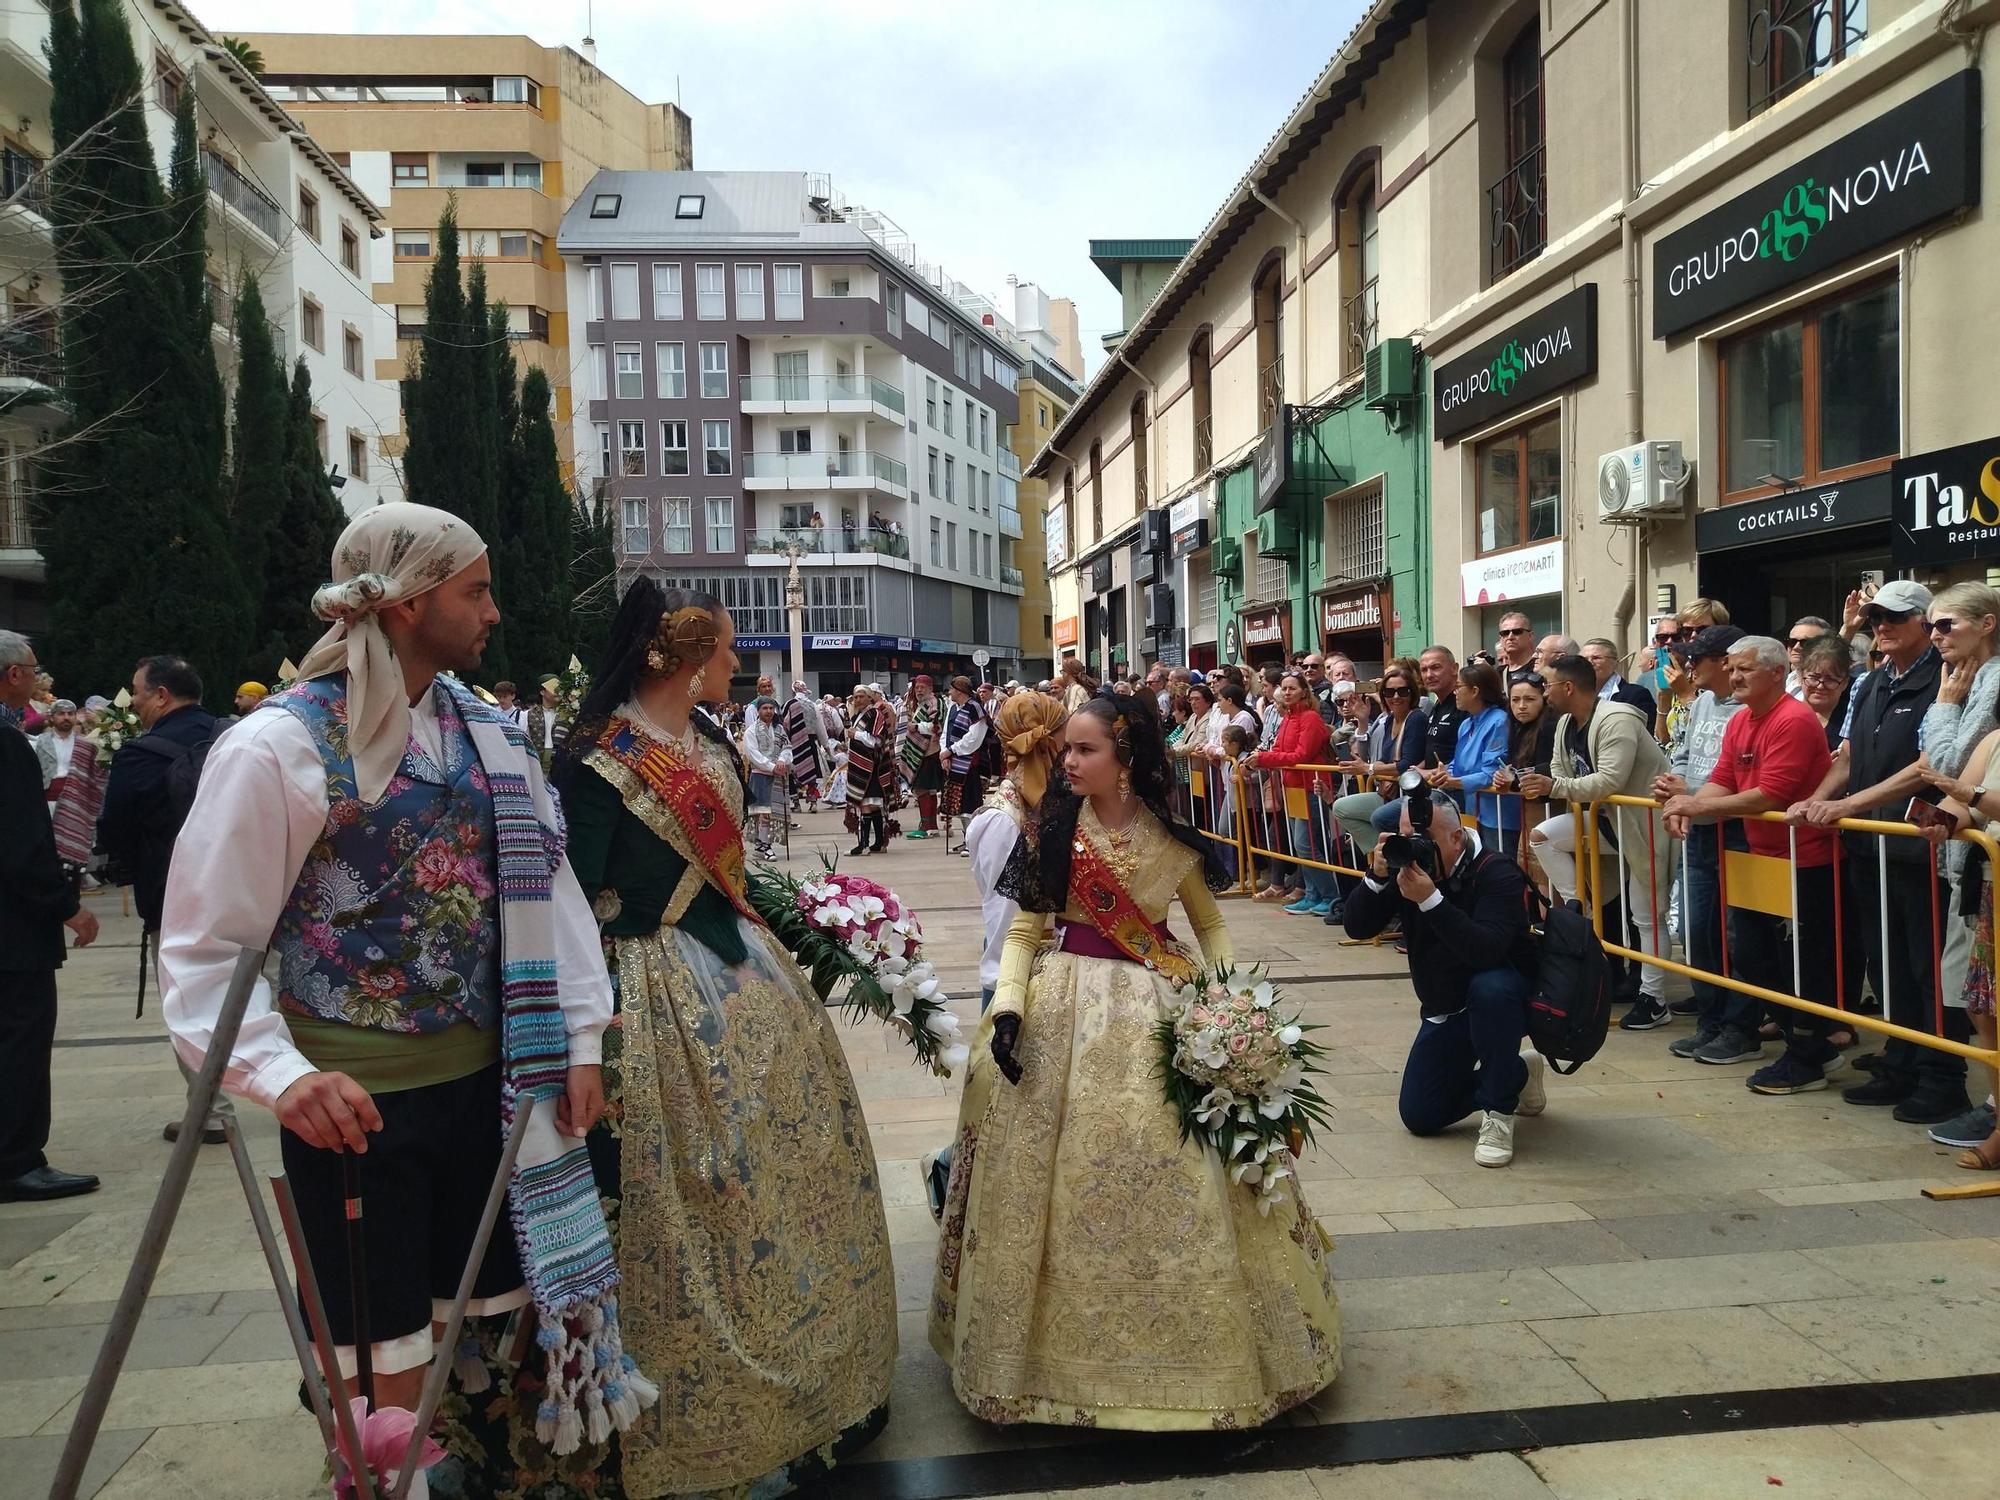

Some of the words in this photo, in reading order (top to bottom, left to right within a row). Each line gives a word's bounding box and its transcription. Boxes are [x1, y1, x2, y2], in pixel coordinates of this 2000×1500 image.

[1668, 227, 1759, 297] GRUPO
[1828, 141, 1931, 222] NOVA
[1442, 368, 1491, 412] GRUPO
[1524, 326, 1573, 373] NOVA
[1738, 501, 1818, 532] COCKTAILS
[1325, 593, 1381, 631] bonanotte
[736, 639, 771, 647] EGUROS
[816, 638, 840, 646] FIATC
[673, 776, 700, 803] 2024
[1074, 863, 1097, 887] 2024
